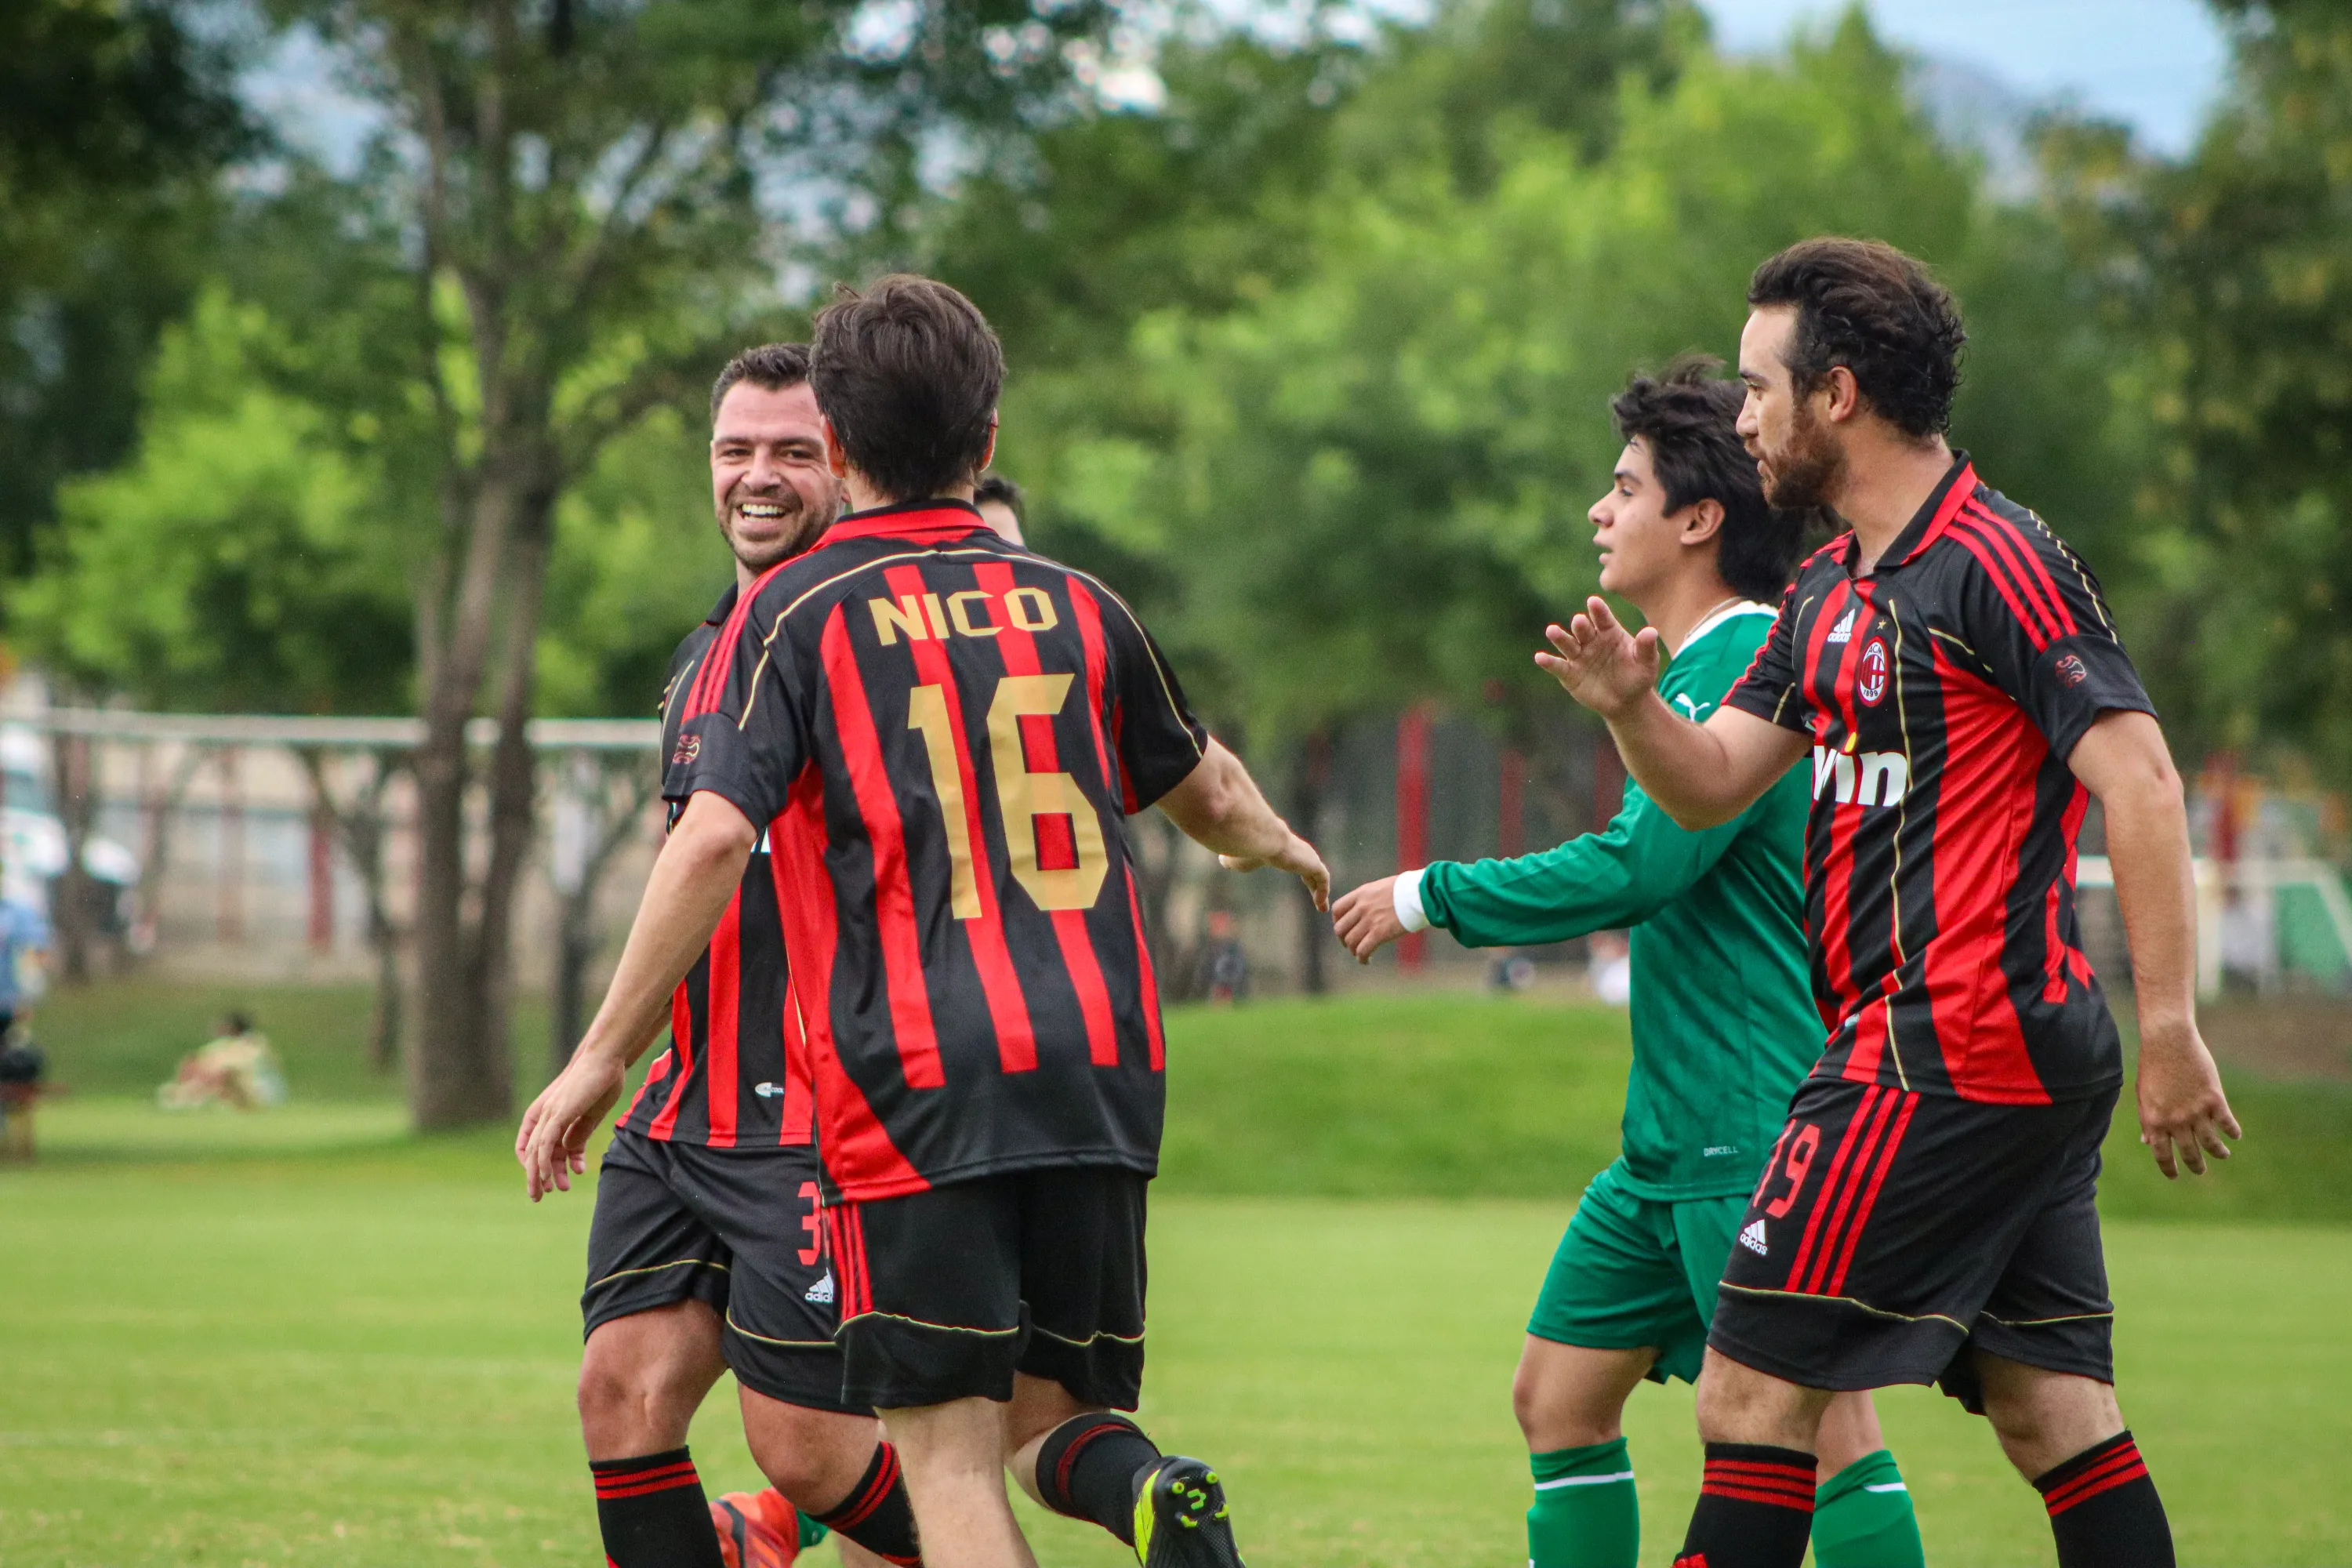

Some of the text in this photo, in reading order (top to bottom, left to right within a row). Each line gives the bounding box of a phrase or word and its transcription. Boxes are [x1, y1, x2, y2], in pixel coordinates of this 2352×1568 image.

[868, 586, 1058, 646] NICO
[1827, 630, 1852, 643] adidas
[1867, 644, 1882, 657] ACM
[1863, 688, 1878, 698] 1899
[907, 673, 1109, 920] 16
[797, 1181, 829, 1266] 3
[1739, 1232, 1768, 1256] adidas
[804, 1285, 833, 1303] adid
